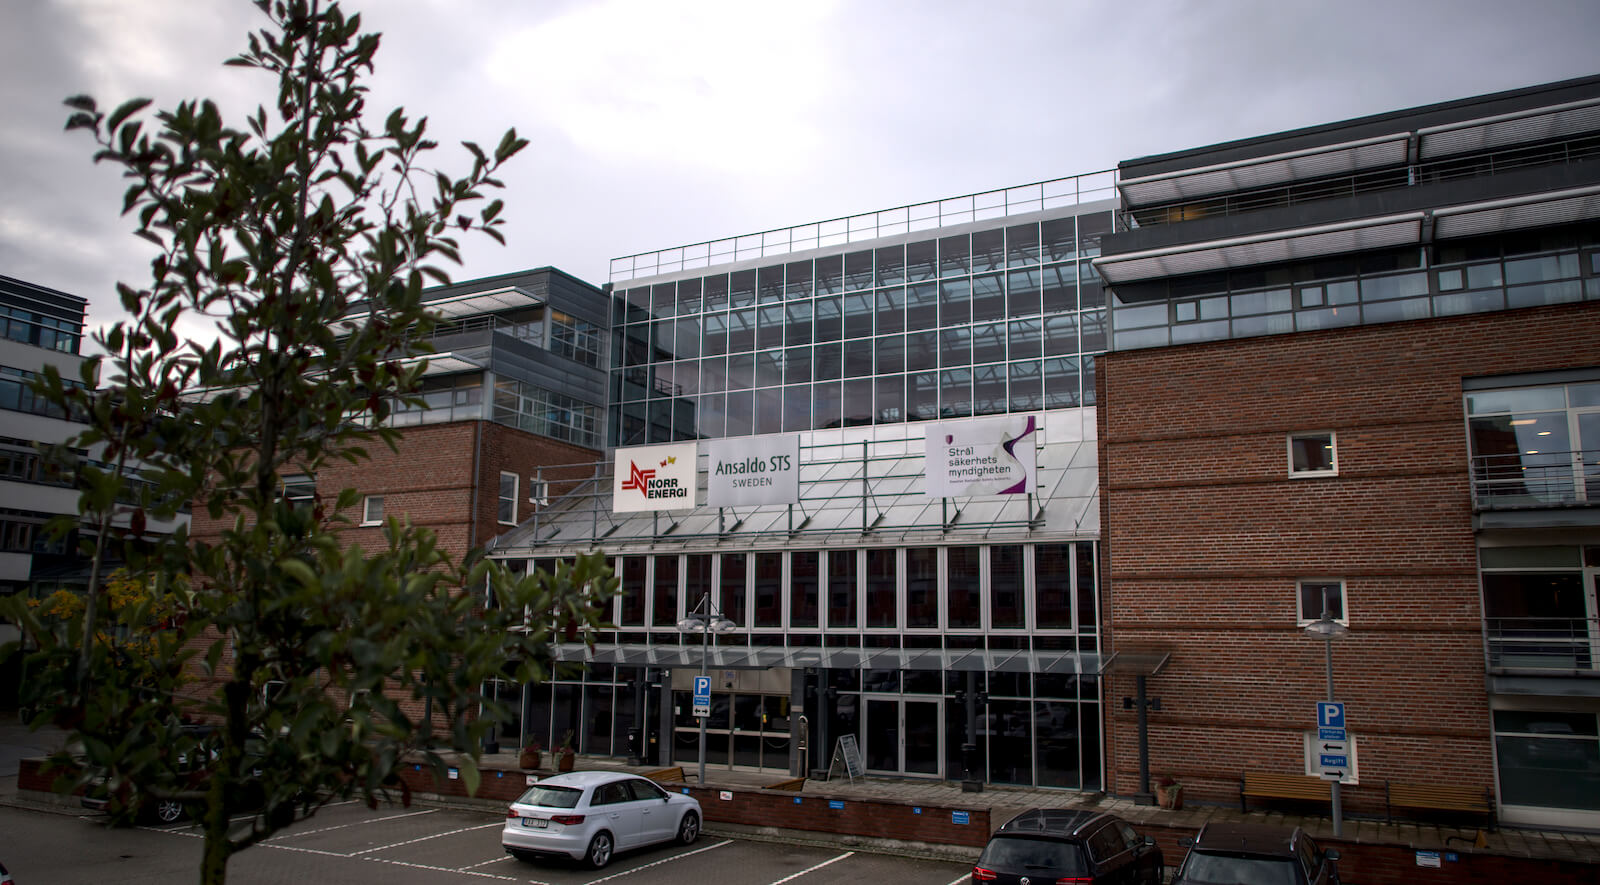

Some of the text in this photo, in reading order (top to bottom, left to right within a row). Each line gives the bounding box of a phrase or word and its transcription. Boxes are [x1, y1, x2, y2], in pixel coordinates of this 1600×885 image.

[949, 446, 974, 457] Strål
[715, 455, 791, 476] Ansaldo STS
[949, 456, 998, 467] säkerhets
[949, 465, 1011, 478] myndigheten
[649, 478, 678, 489] NORR
[732, 477, 772, 488] SWEDEN
[648, 487, 687, 499] ENERGI
[698, 679, 708, 694] P
[1324, 704, 1340, 725] P
